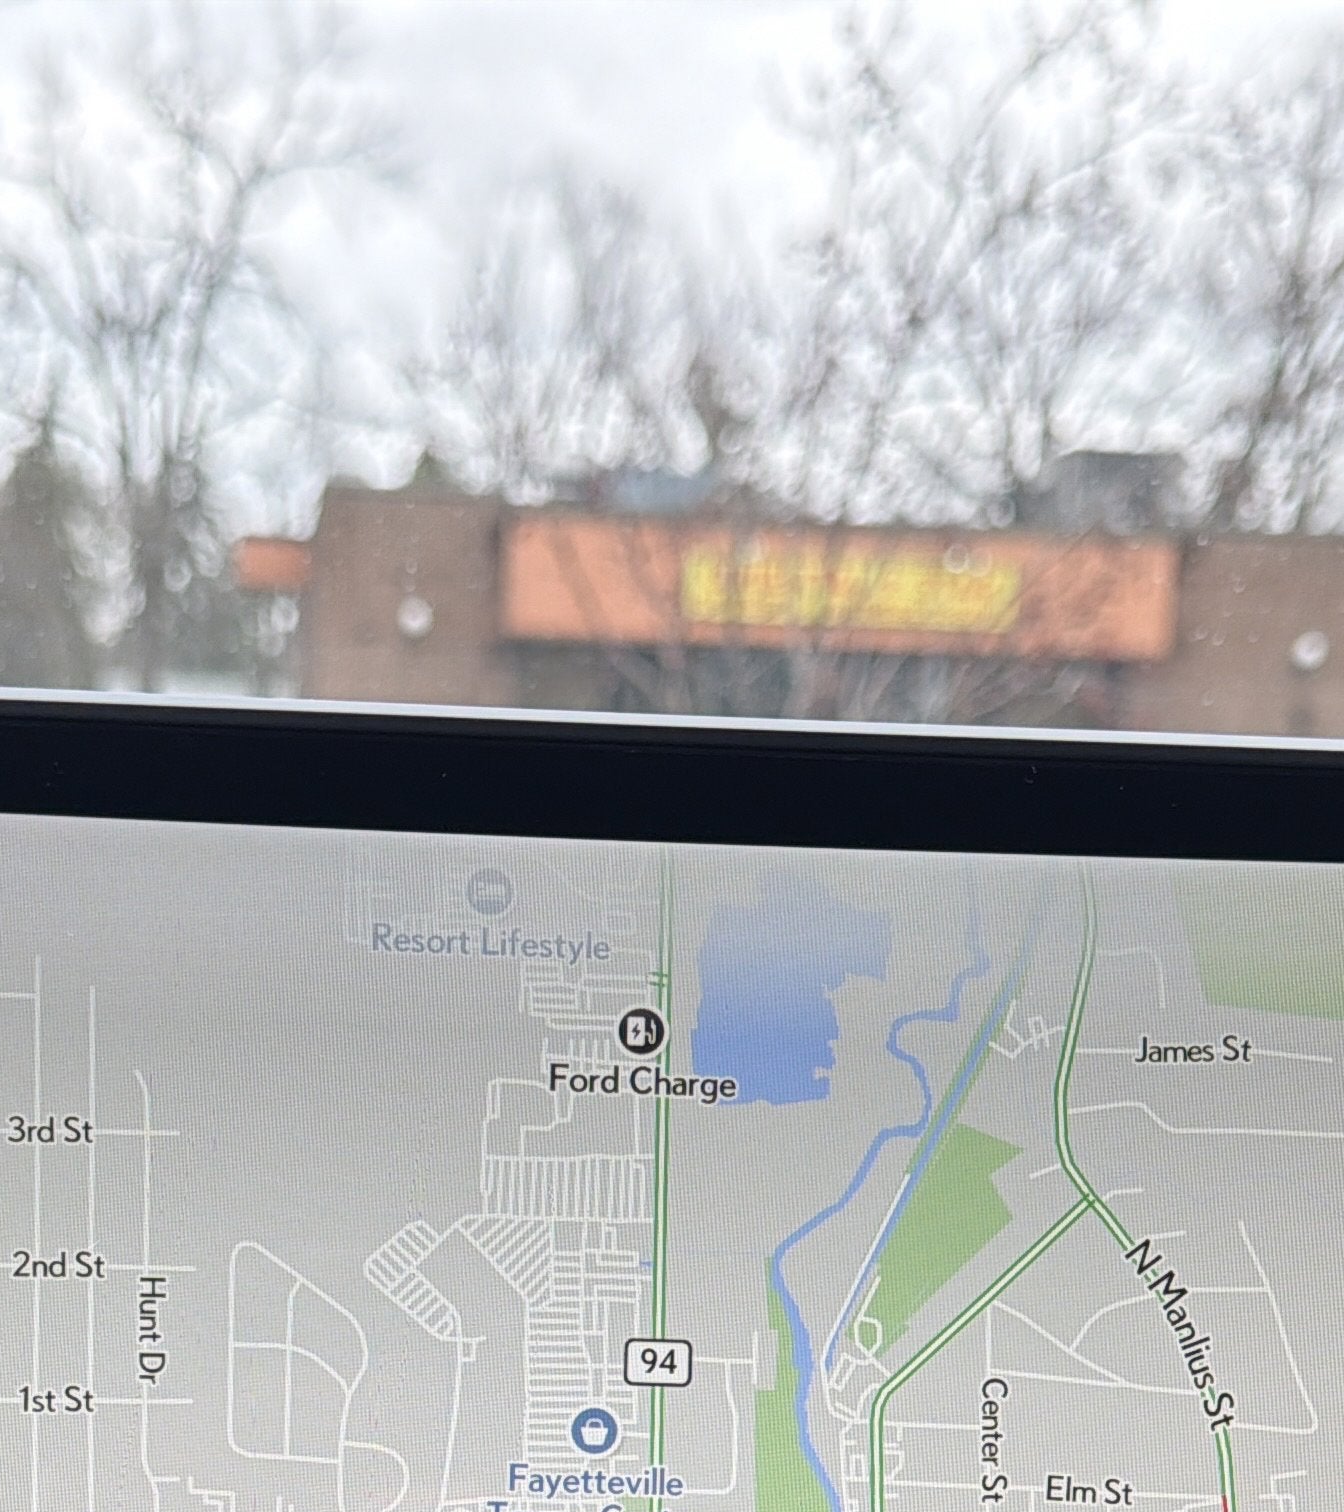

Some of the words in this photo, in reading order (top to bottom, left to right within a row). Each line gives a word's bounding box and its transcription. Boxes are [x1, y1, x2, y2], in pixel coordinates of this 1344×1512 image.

[372, 922, 469, 954] Resort
[481, 926, 610, 966] Lifestyle
[1135, 1037, 1214, 1063] James
[1222, 1034, 1252, 1063] St
[550, 1063, 619, 1093] Ford
[630, 1066, 737, 1104] Charge
[8, 1115, 55, 1143] 3rd
[63, 1116, 94, 1143] St
[12, 1251, 66, 1278] 2nd
[75, 1251, 106, 1278] St
[138, 1277, 166, 1343] Hunt
[1125, 1239, 1163, 1275] N
[1148, 1270, 1215, 1390] Manlius
[1203, 1392, 1235, 1431] St
[138, 1352, 166, 1386] Dr
[641, 1346, 678, 1374] 94
[18, 1386, 56, 1413] 1st
[64, 1386, 95, 1413] St
[981, 1378, 1009, 1466] Center
[508, 1463, 684, 1500] Fayetteville
[981, 1474, 1009, 1504] St
[1046, 1475, 1099, 1502] Elm
[1104, 1477, 1133, 1505] St
